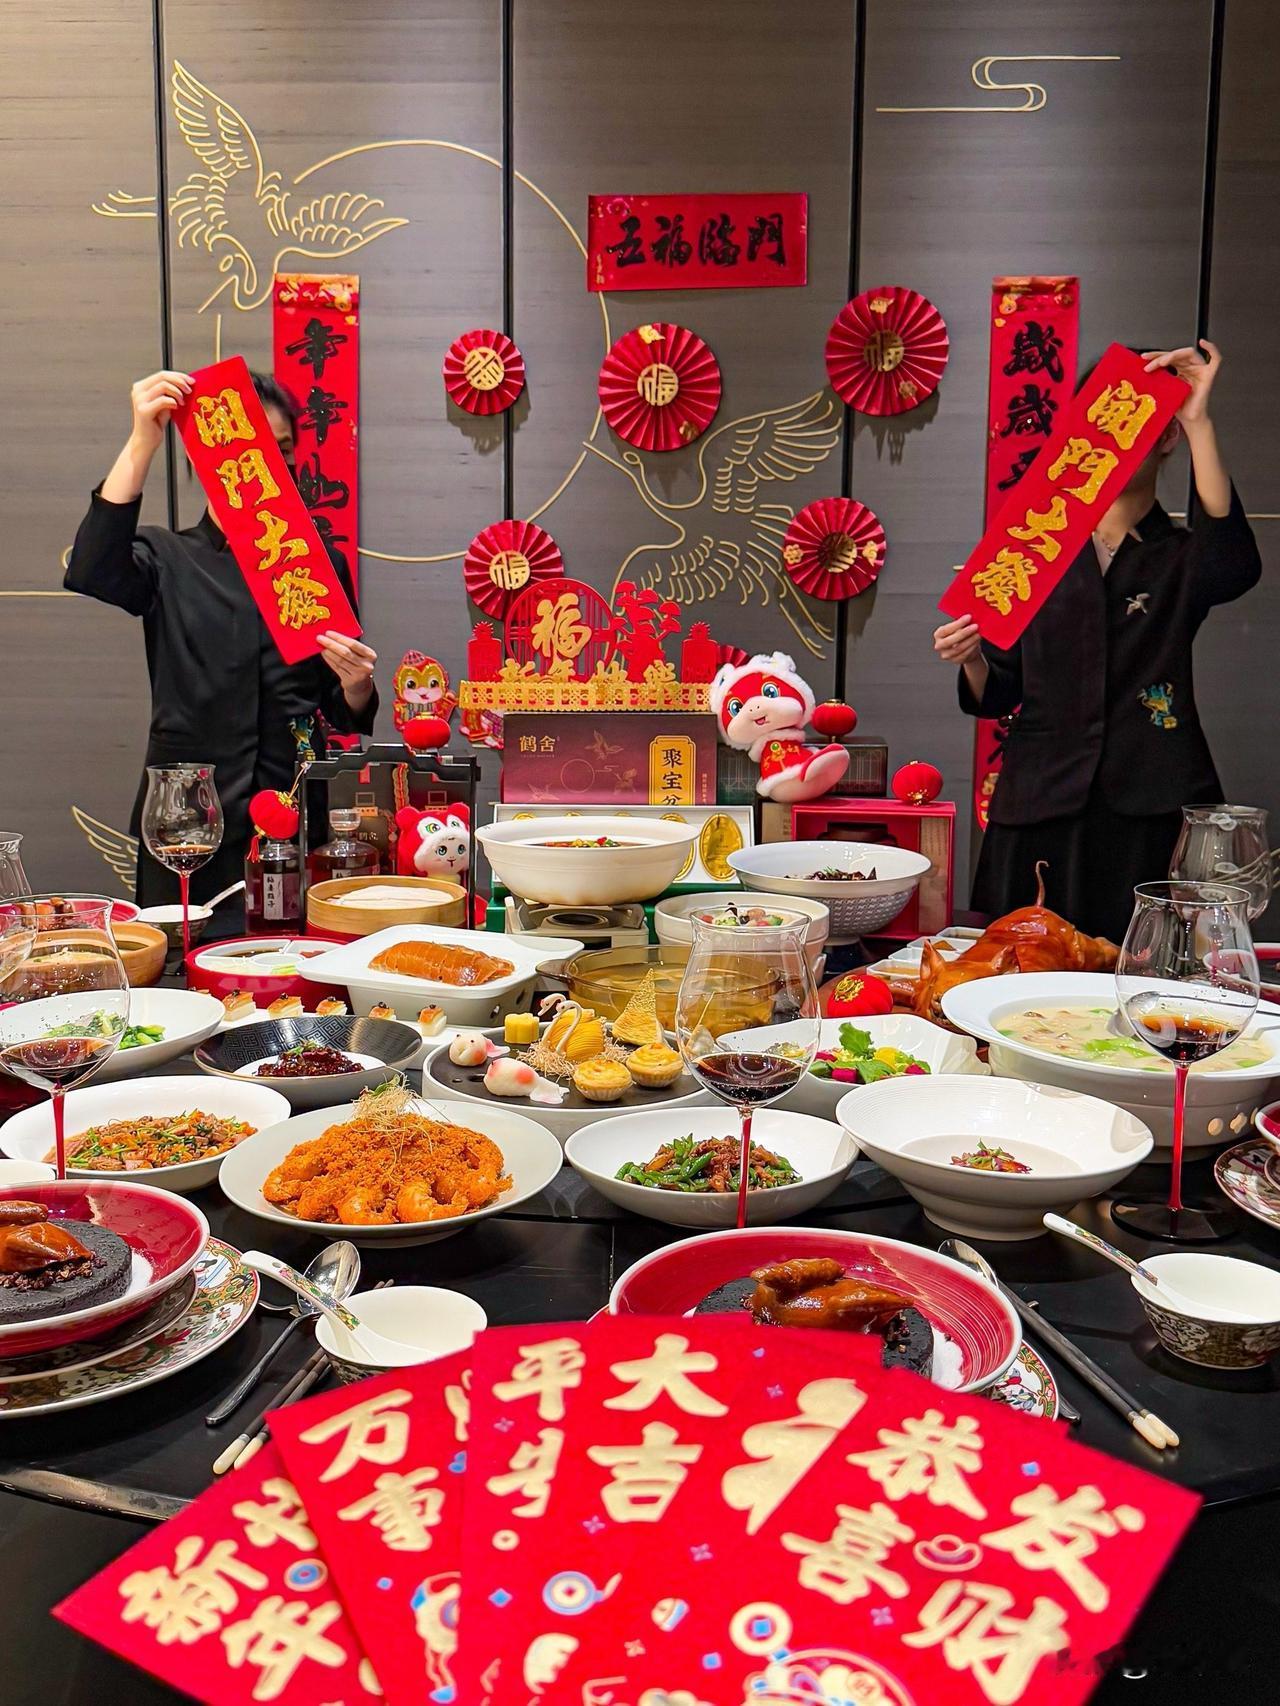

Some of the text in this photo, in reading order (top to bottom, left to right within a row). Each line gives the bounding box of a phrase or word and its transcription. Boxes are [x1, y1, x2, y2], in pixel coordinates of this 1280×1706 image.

[605, 212, 787, 268] 五福臨門
[637, 363, 680, 406] 福
[490, 551, 531, 591] 福
[531, 592, 592, 659] 福
[519, 735, 556, 753] 鹤舍
[587, 1333, 729, 1522] 大吉
[781, 1408, 988, 1604] 恭喜
[118, 1536, 348, 1701] 新年
[902, 1483, 1146, 1705] 发财
